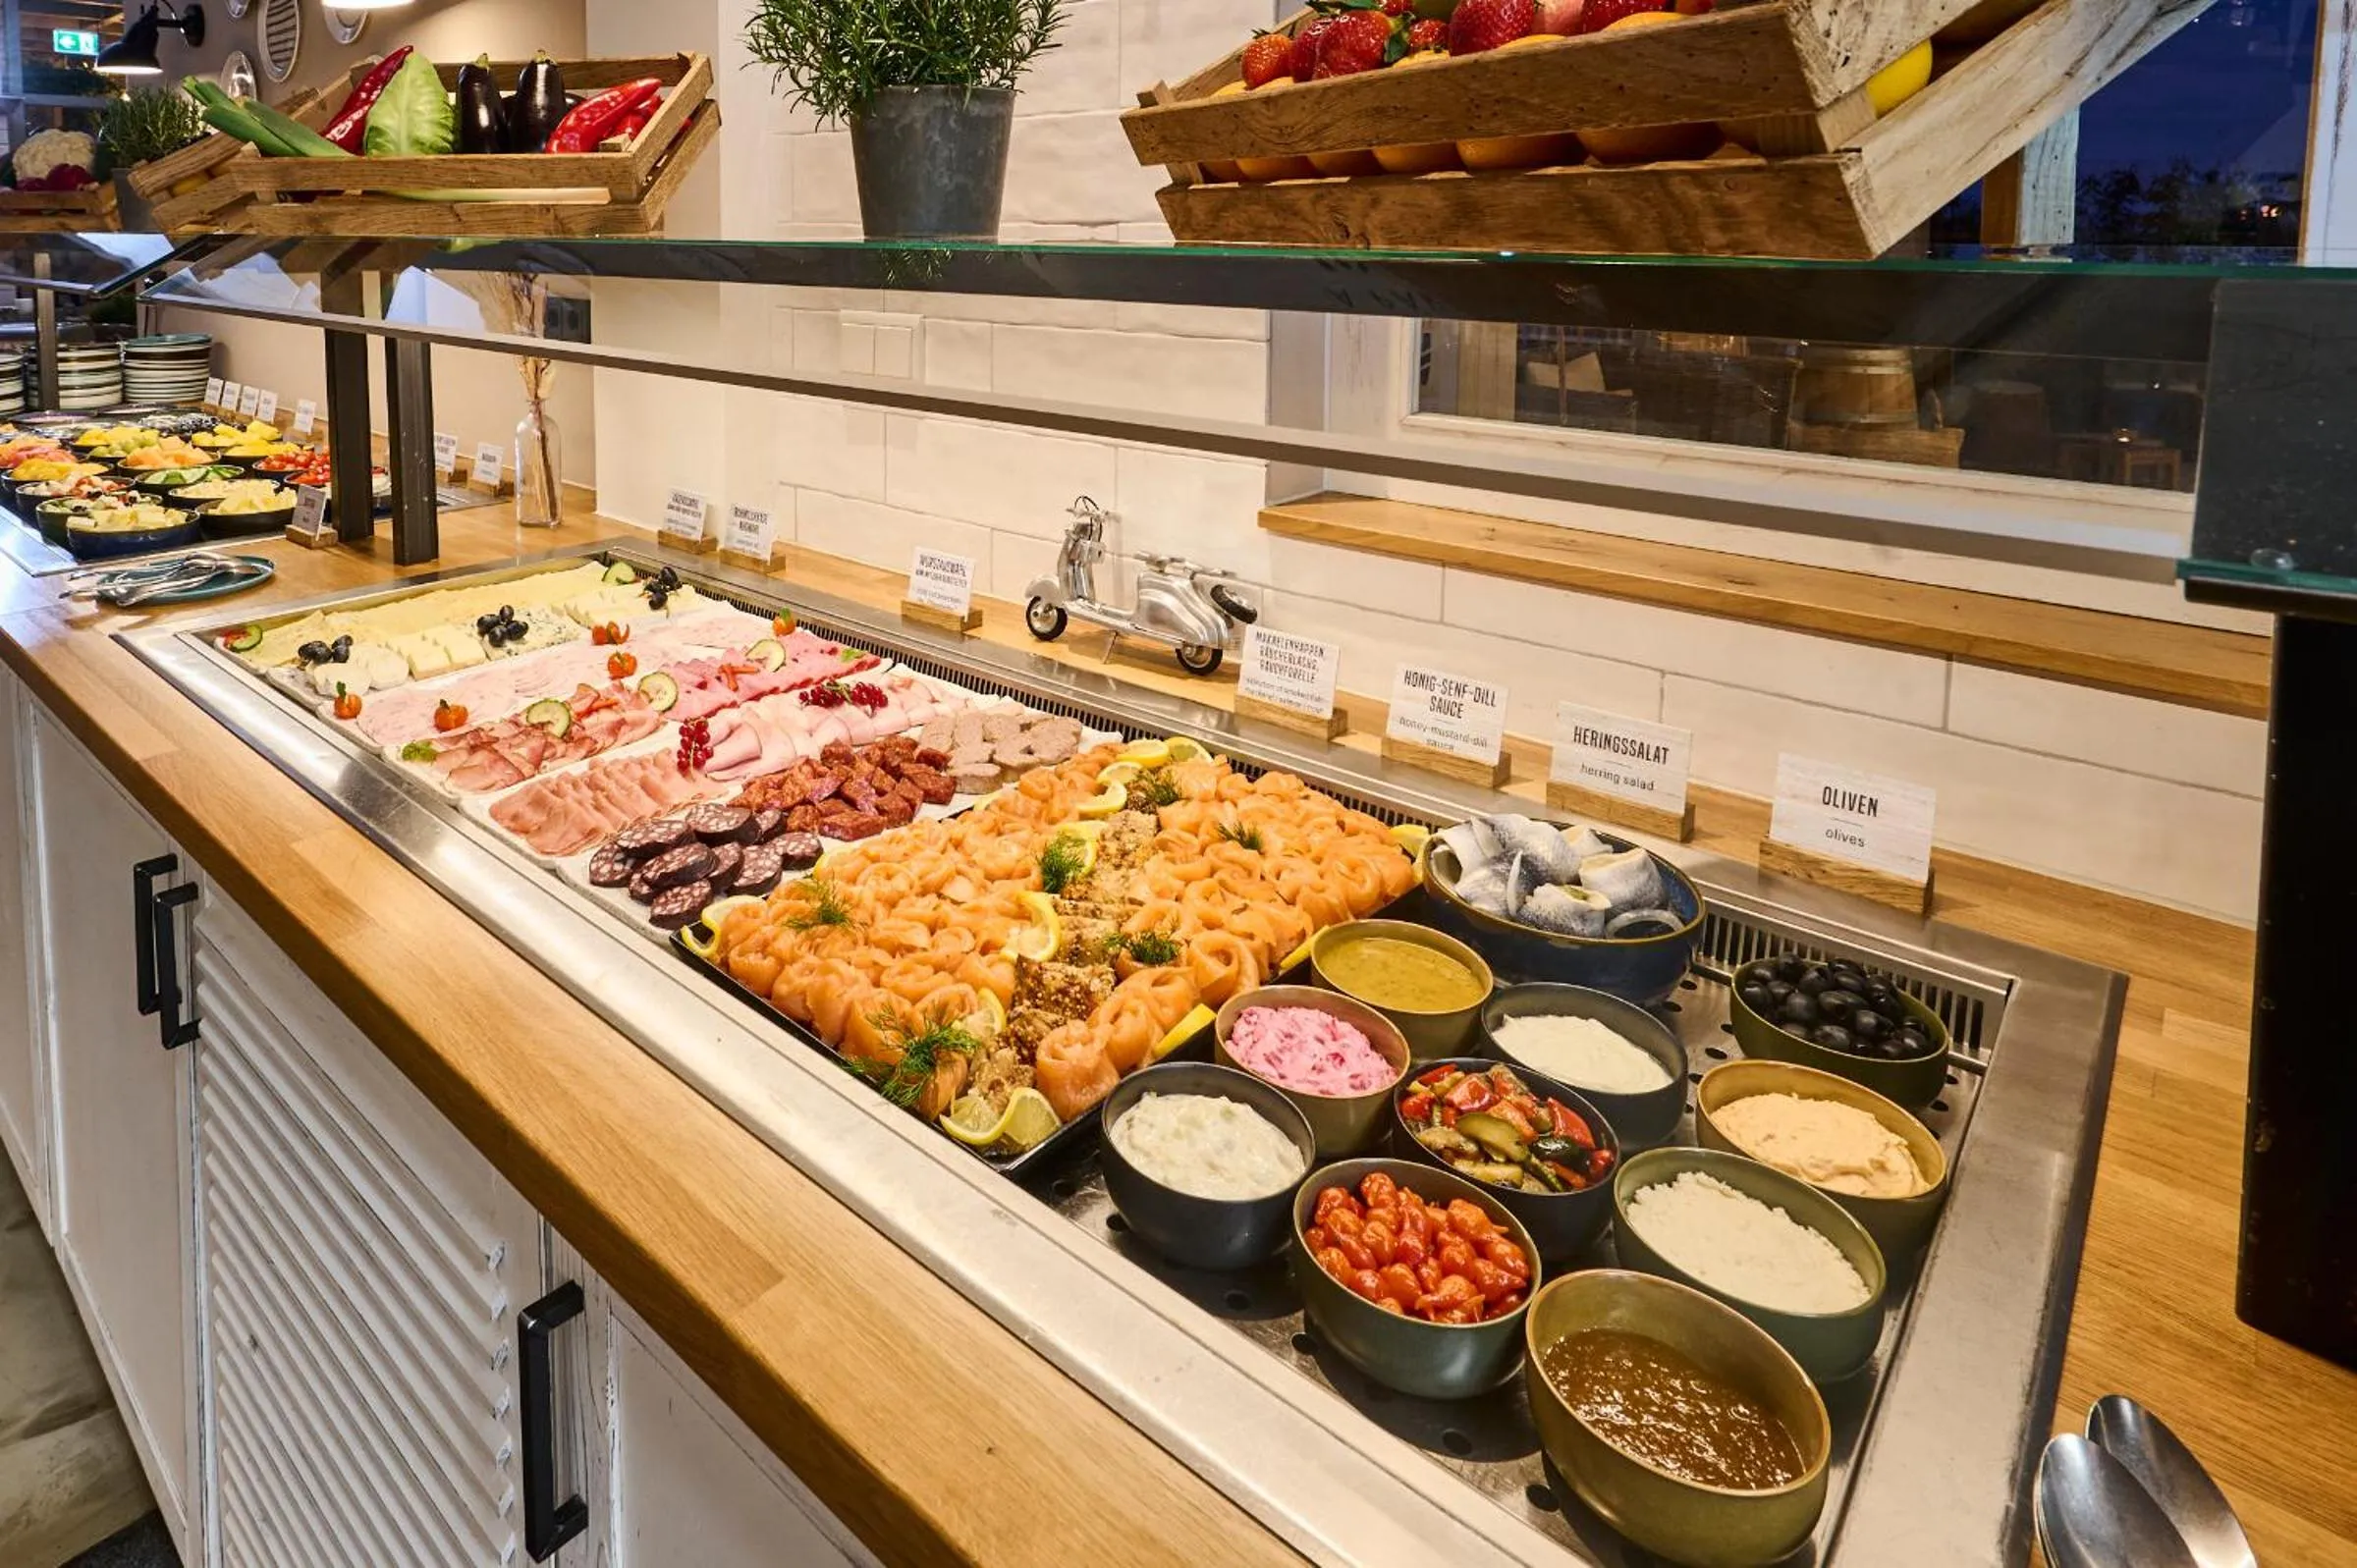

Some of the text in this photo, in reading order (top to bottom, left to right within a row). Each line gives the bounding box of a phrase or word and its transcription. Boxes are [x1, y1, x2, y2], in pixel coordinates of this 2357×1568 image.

[1403, 670, 1497, 708] HONIG-SENF-DILL
[1429, 695, 1464, 719] SAUCE
[1573, 726, 1670, 765] HERINGSSALAT
[1580, 762, 1655, 791] herring salad
[1822, 785, 1878, 817] OLIVEN
[1825, 828, 1865, 847] olives
